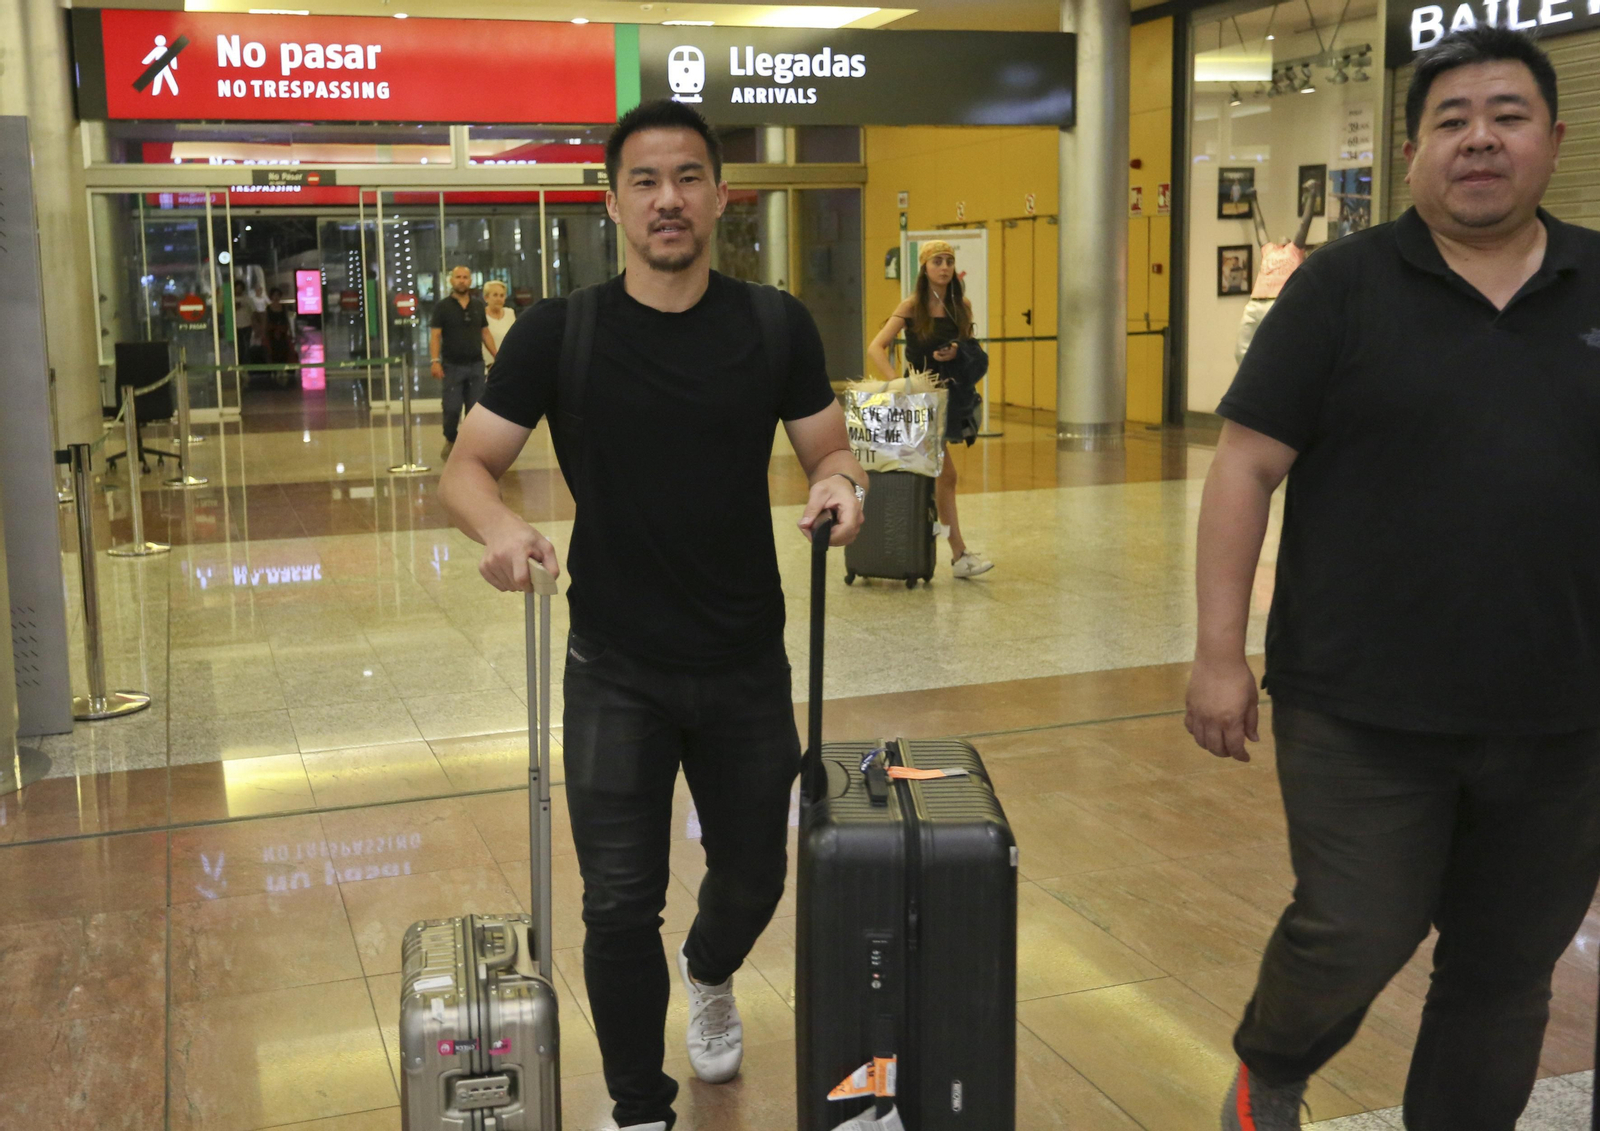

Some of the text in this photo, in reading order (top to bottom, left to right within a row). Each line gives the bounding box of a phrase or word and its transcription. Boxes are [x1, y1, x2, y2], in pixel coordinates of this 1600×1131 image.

[1410, 0, 1600, 51] BATLE
[216, 34, 382, 76] No pasar
[729, 45, 867, 84] Llegadas
[217, 79, 391, 100] NO TRESPASSING
[730, 86, 818, 104] ARRIVALS
[887, 406, 934, 424] MADDEN
[848, 426, 902, 444] MADE ME
[866, 449, 877, 463] IT
